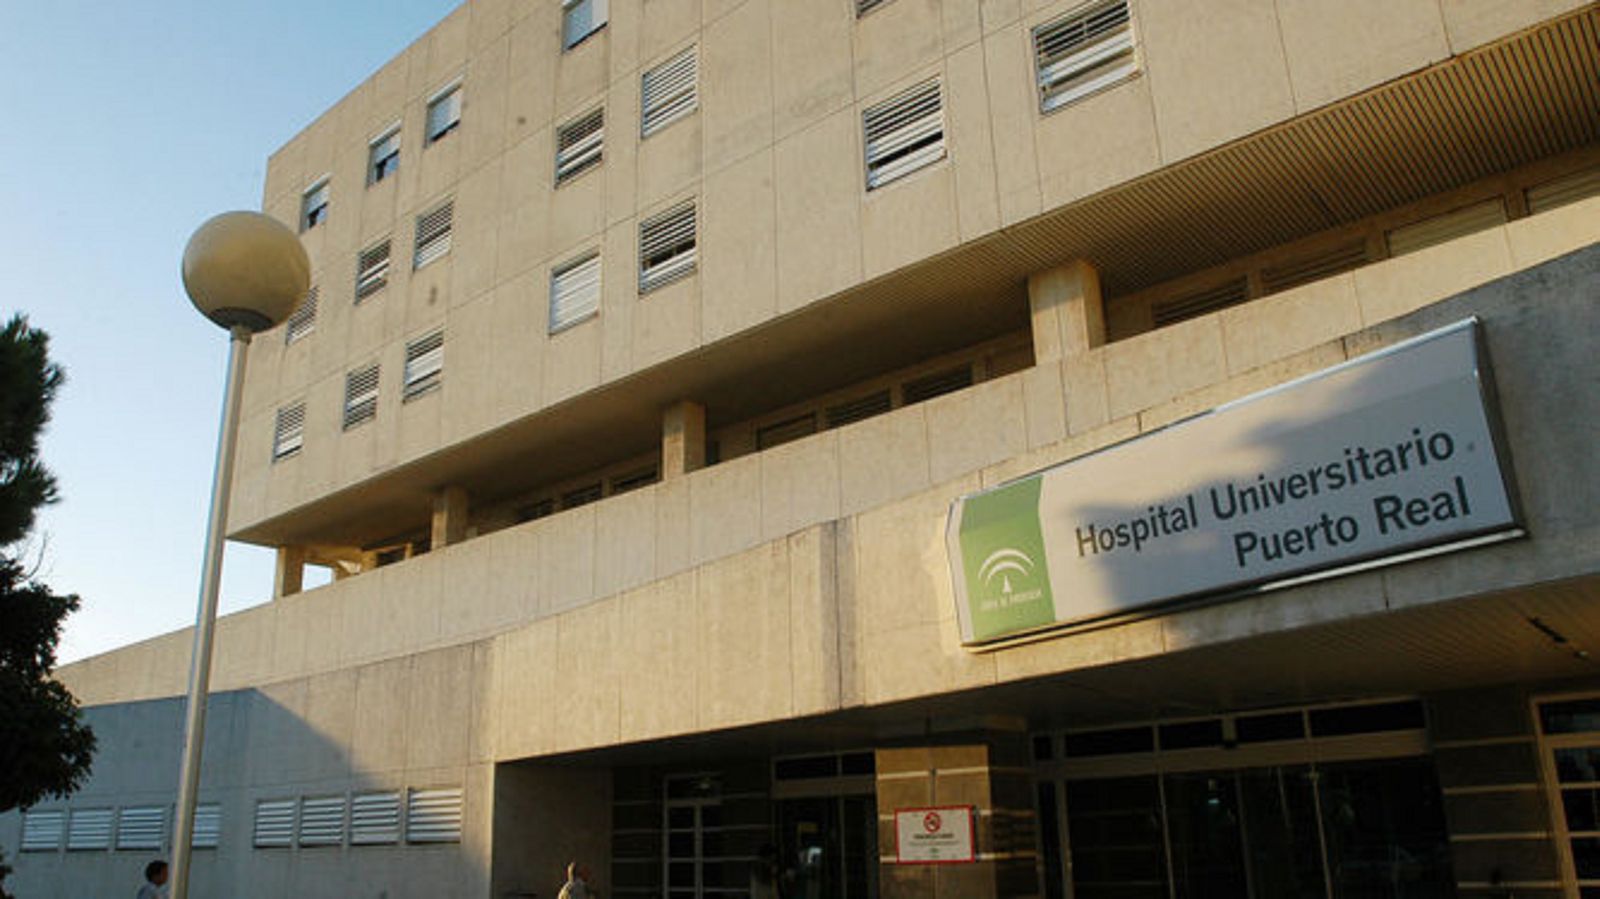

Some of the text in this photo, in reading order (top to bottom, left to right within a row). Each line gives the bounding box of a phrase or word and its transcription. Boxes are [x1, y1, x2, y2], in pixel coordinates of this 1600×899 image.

[1076, 427, 1455, 557] Hospital Universitario
[1234, 476, 1471, 568] Puerto Real
